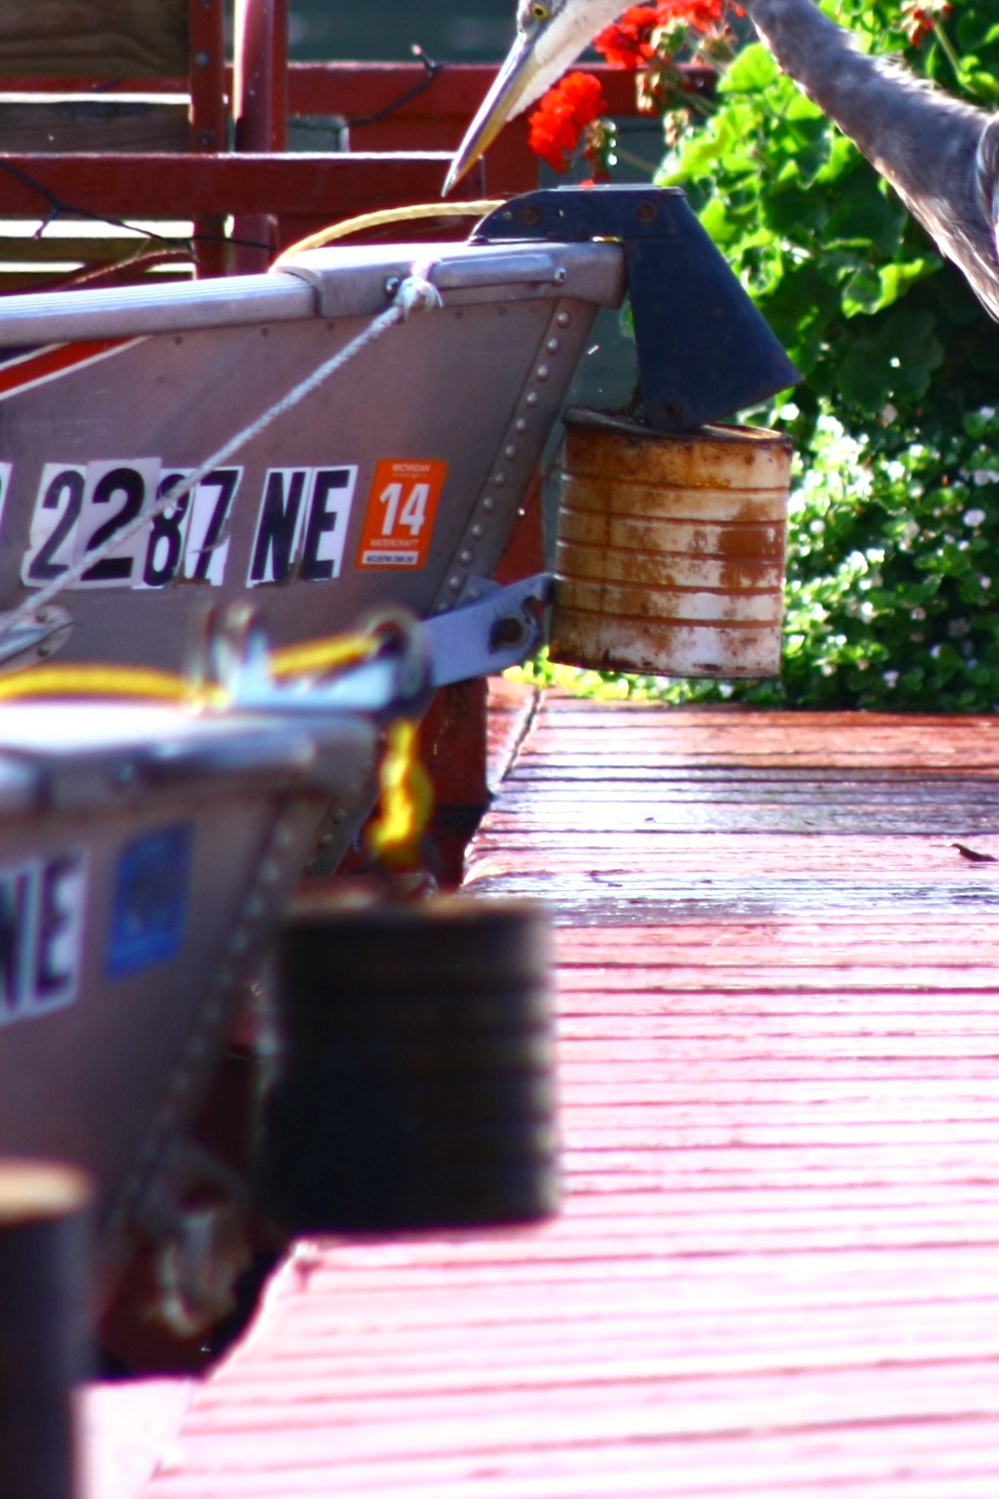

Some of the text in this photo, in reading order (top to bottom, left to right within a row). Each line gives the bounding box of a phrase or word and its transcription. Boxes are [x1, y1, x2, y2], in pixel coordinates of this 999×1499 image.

[28, 467, 352, 587] 2287 NE
[379, 482, 430, 536] 14
